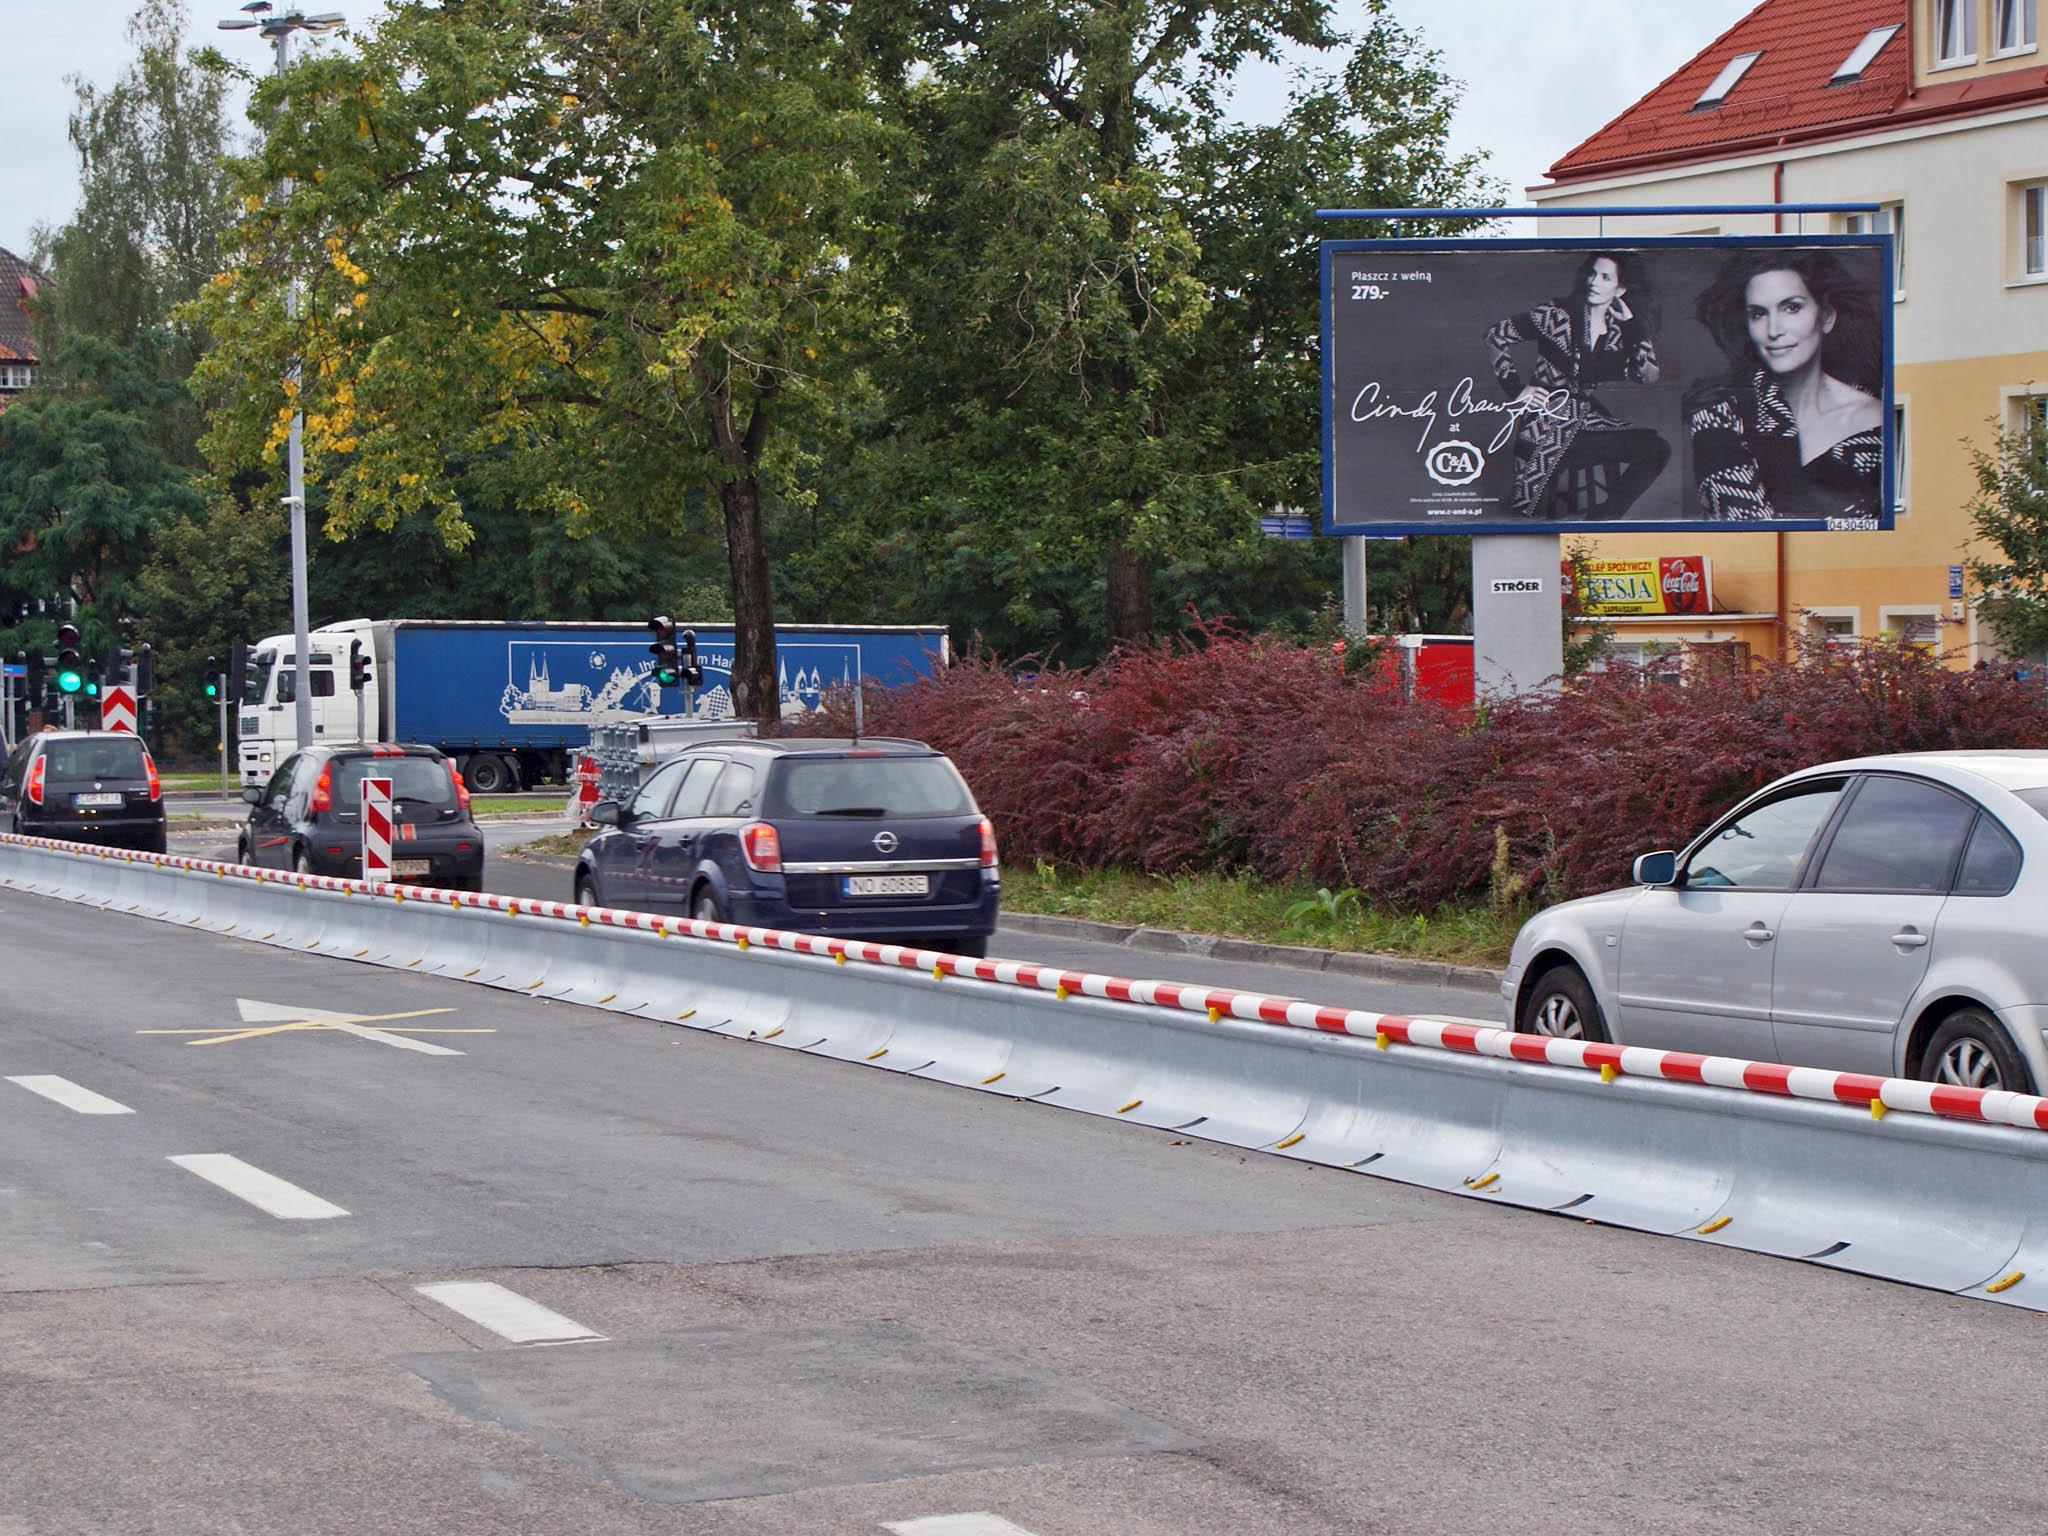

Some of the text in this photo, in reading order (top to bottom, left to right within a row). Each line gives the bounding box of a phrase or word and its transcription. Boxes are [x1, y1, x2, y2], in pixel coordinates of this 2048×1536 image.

[1352, 271, 1432, 283] Płaszcz z wełną
[1351, 377, 1569, 454] Cindy Crawford
[1449, 423, 1460, 432] at
[1436, 452, 1475, 473] C&A
[1427, 508, 1482, 516] www.c-and-a.pl
[1829, 520, 1876, 530] 0430401
[1608, 561, 1652, 572] SPOŻYWCZY
[1663, 571, 1699, 593] Coca-Cola
[638, 659, 657, 673] Ihr
